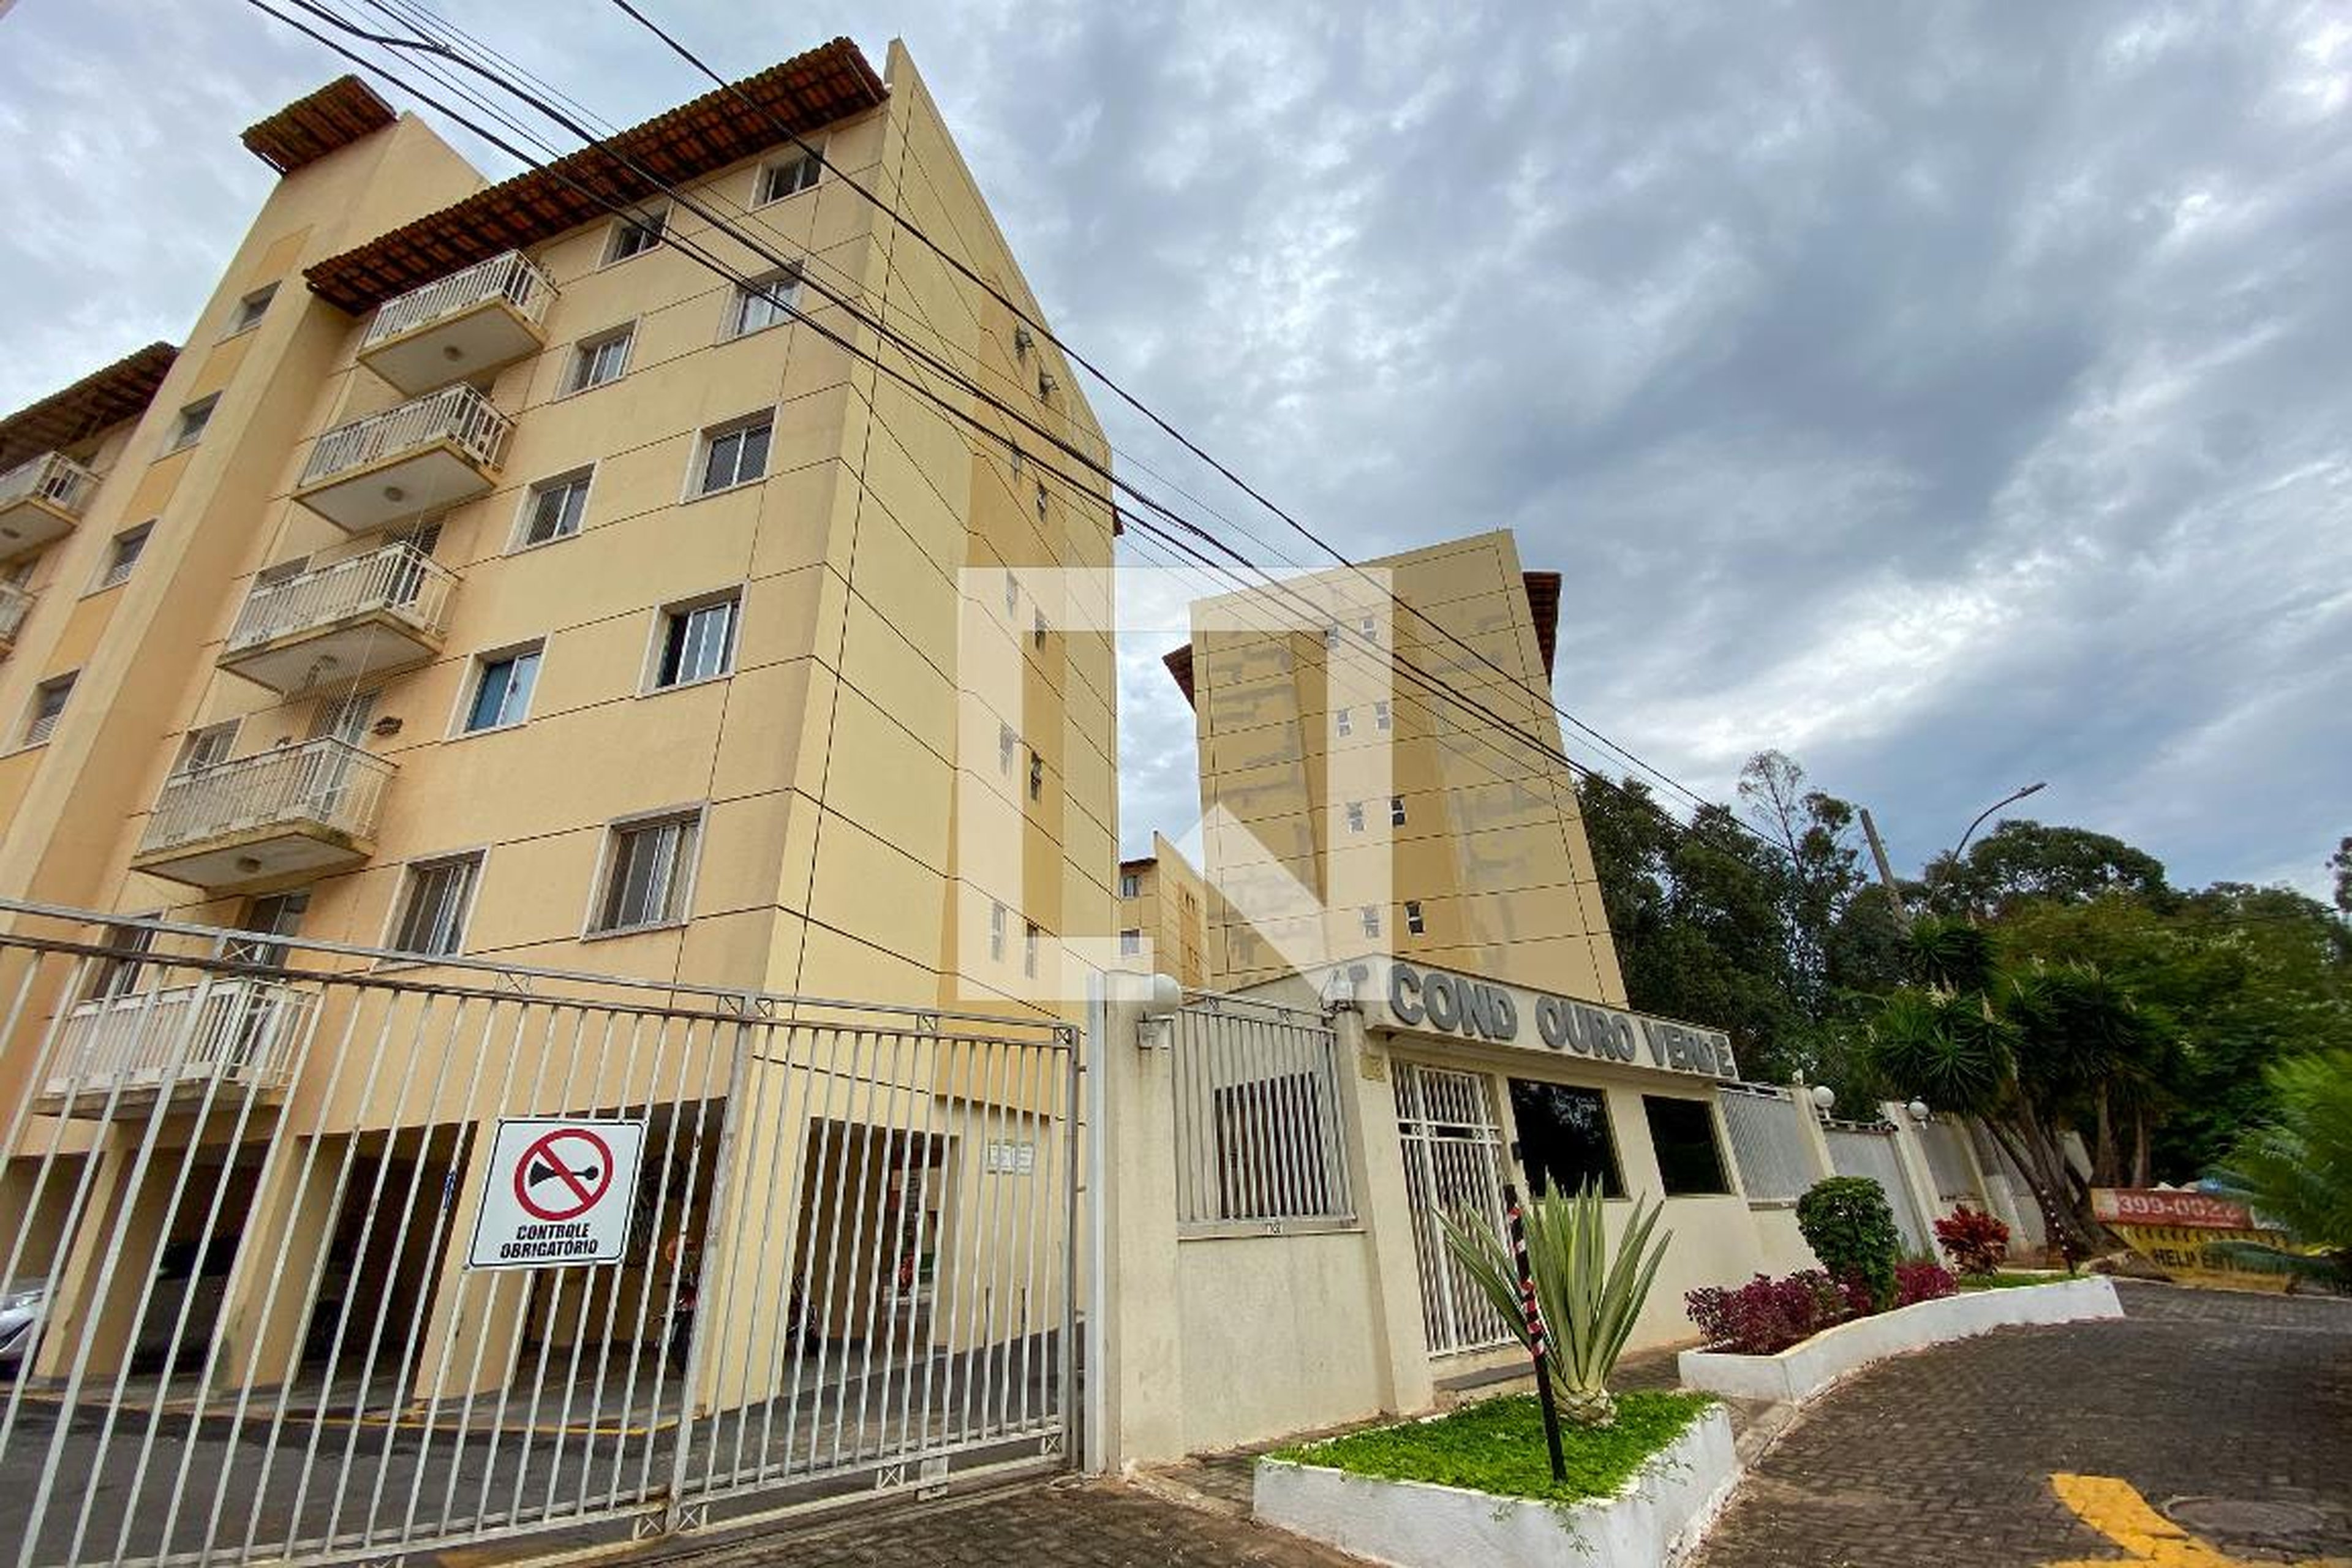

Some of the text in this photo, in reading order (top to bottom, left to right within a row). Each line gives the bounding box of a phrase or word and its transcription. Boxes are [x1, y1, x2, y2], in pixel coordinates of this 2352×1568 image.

[1387, 963, 1735, 1076] COND OURO VERDE
[516, 1223, 590, 1240] CONTROLE
[500, 1238, 598, 1258] OBRIGATÓRIO
